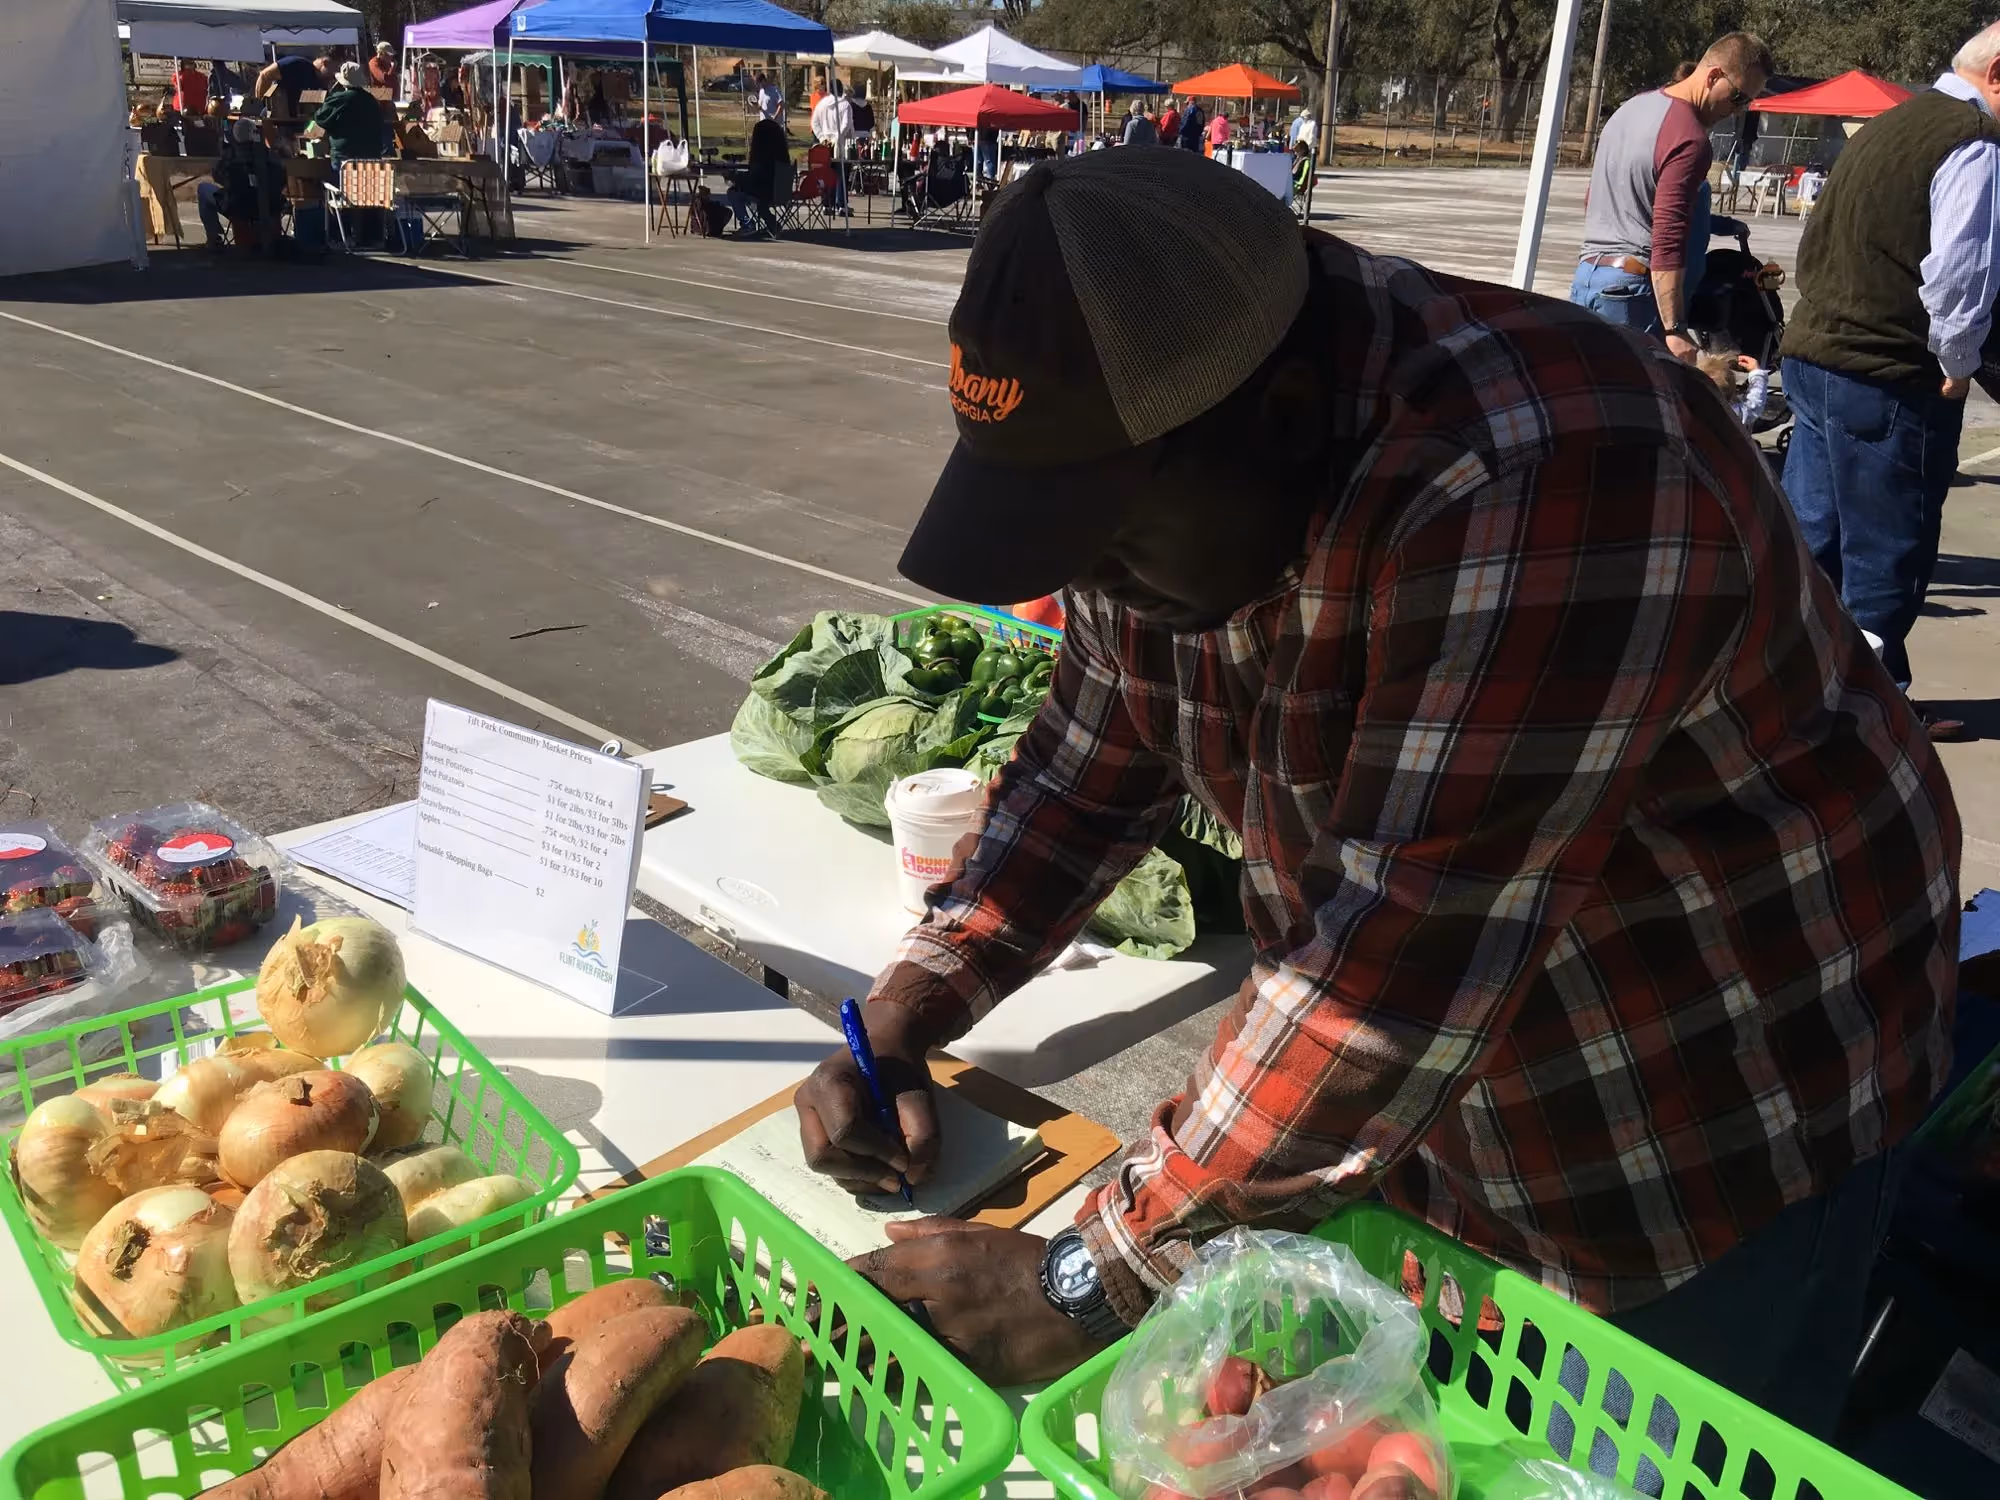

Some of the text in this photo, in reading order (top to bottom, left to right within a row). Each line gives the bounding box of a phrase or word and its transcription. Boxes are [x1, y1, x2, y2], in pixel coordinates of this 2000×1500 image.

[950, 343, 1024, 421] lbany
[427, 736, 459, 754] Tomatoes
[595, 795, 606, 807] for
[481, 719, 497, 733] Park
[498, 723, 541, 747] Community
[542, 739, 568, 757] Market
[570, 749, 593, 765] Prices
[422, 781, 446, 796] Onions
[590, 843, 602, 855] for
[424, 766, 437, 778] Red
[438, 772, 465, 788] Potatoes
[555, 813, 567, 825] for
[597, 828, 608, 840] for
[609, 833, 626, 846] 5lbs
[425, 752, 445, 765] Sweet
[445, 758, 474, 776] Potatoes
[557, 797, 568, 809] for
[598, 813, 610, 825] for
[611, 817, 628, 831] 5lbs
[420, 811, 440, 825] Apples
[539, 856, 548, 867] $1
[549, 859, 561, 871] for
[580, 872, 592, 884] for
[593, 877, 603, 888] 10
[421, 796, 461, 816] Strawberries
[541, 840, 550, 851] $3
[551, 844, 562, 856] for
[583, 856, 594, 868] for
[916, 856, 951, 867] DUNK
[445, 851, 476, 872] Shopping
[477, 863, 493, 877] Bags
[535, 887, 545, 898] $2
[559, 951, 576, 968] FLINT
[593, 967, 613, 984] FRESH
